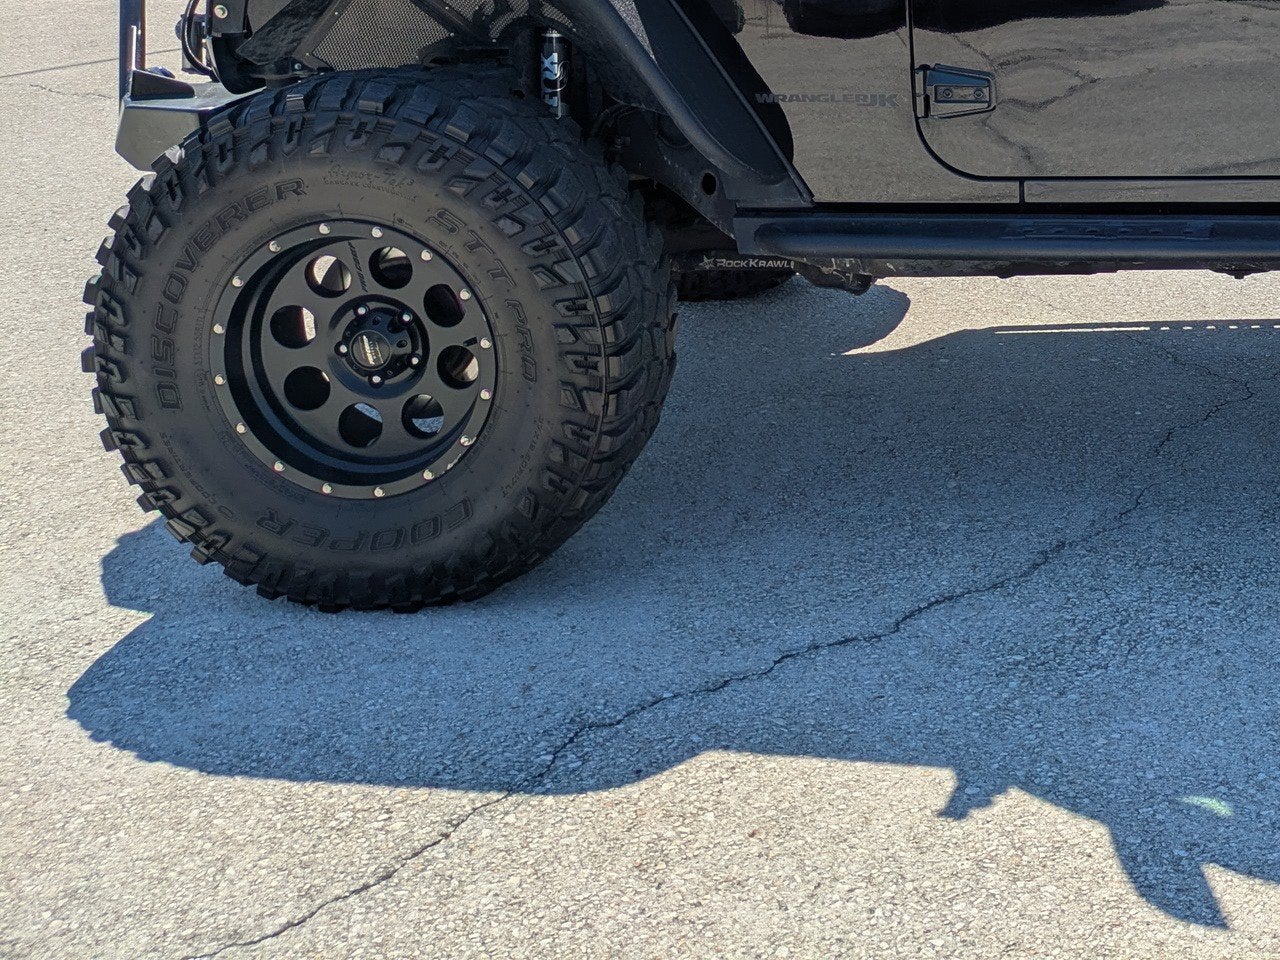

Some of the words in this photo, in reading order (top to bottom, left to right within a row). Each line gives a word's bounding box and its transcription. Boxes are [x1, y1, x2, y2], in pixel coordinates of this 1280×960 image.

[152, 178, 309, 412] DISCOVERER
[430, 209, 515, 286] STT
[503, 299, 538, 384] PRO
[256, 497, 475, 554] COOPER
